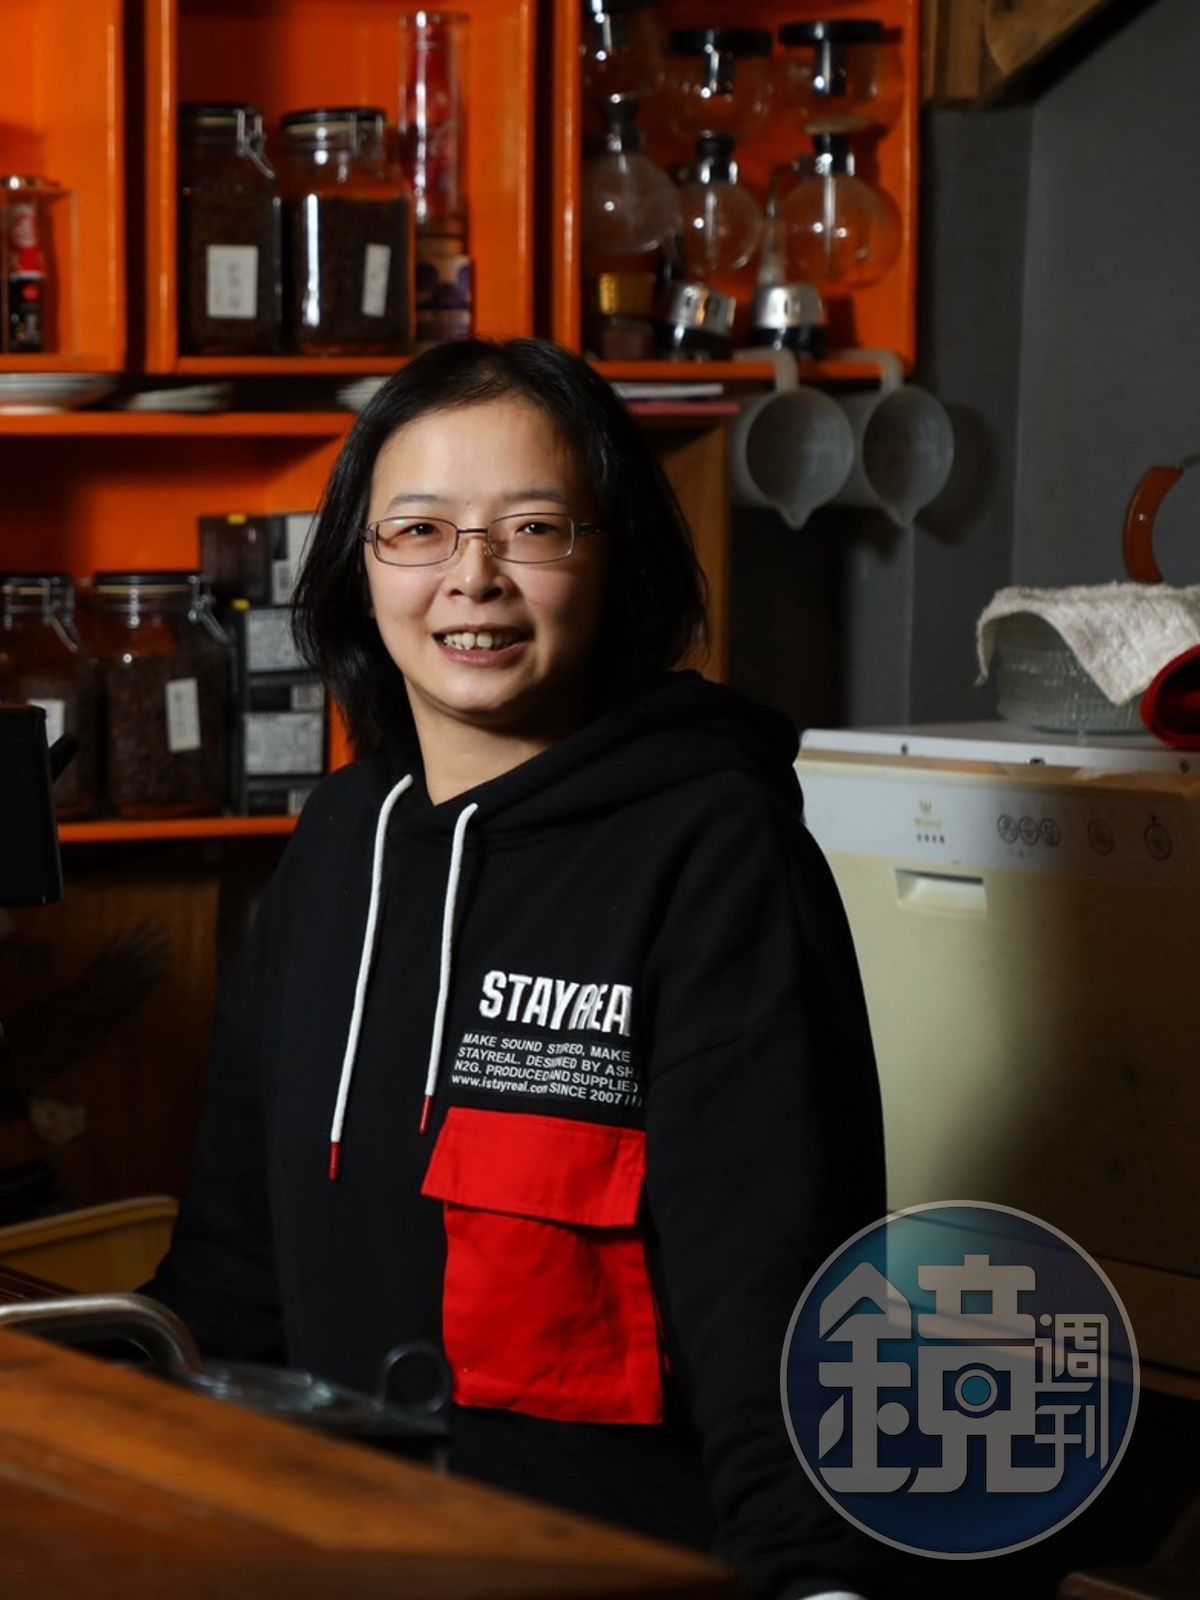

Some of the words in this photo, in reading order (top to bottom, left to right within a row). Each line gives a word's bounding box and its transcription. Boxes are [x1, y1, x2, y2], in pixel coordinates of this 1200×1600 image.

[479, 970, 632, 1036] STAYREA
[462, 1032, 498, 1048] MAKE
[501, 1037, 542, 1053] SOUND
[590, 1045, 631, 1063] MAKE
[581, 1058, 601, 1074] BY
[549, 1081, 587, 1099] SINCE
[590, 1088, 622, 1104] 2007
